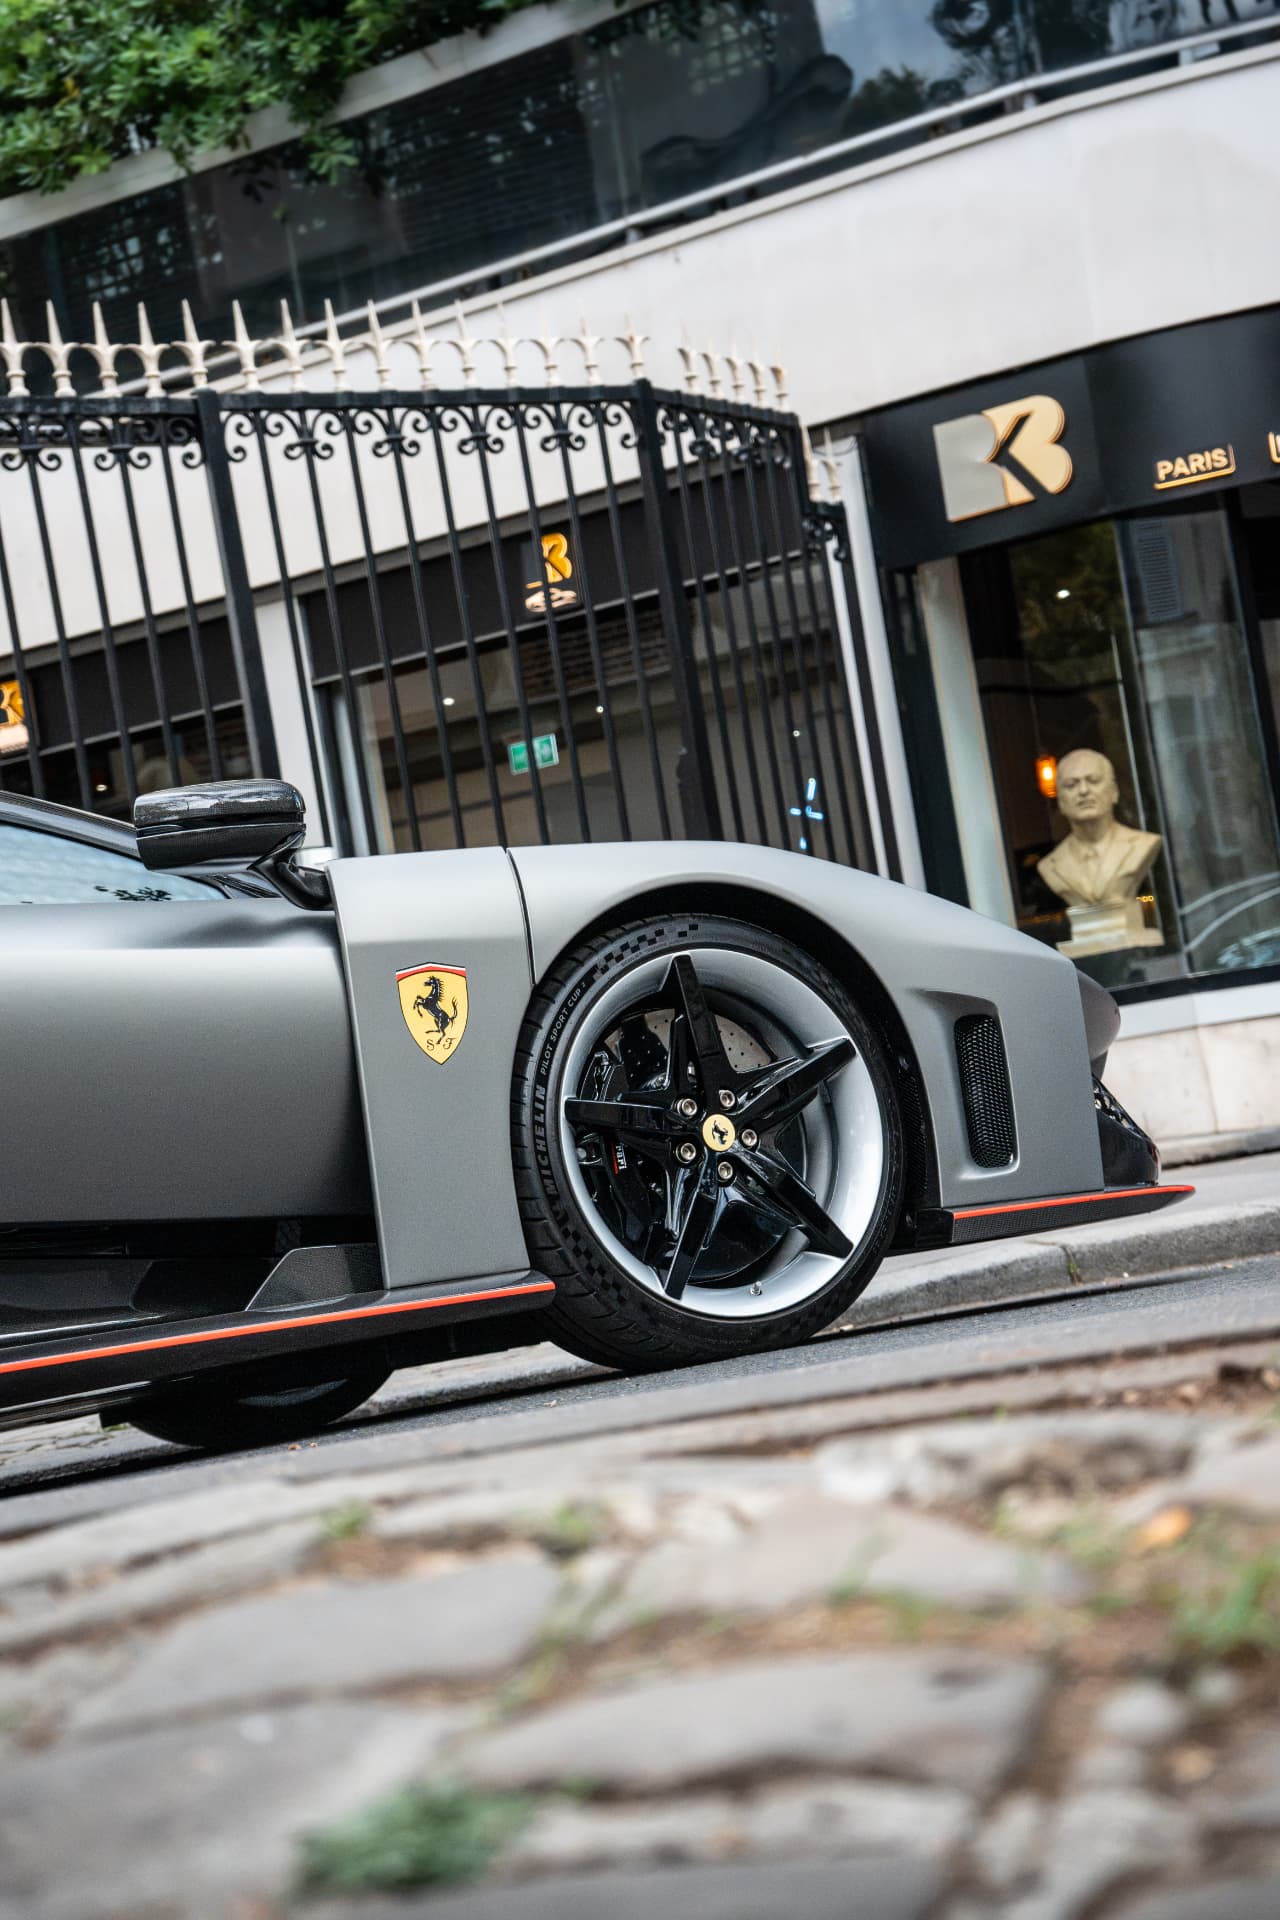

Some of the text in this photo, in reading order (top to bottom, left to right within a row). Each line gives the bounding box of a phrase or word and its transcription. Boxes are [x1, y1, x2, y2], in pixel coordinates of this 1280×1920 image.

[1156, 447, 1229, 482] PARIS
[567, 987, 582, 1007] CUP
[550, 1008, 569, 1042] SPORT
[540, 1043, 553, 1076] PILOT
[534, 1084, 559, 1196] MICHELIN
